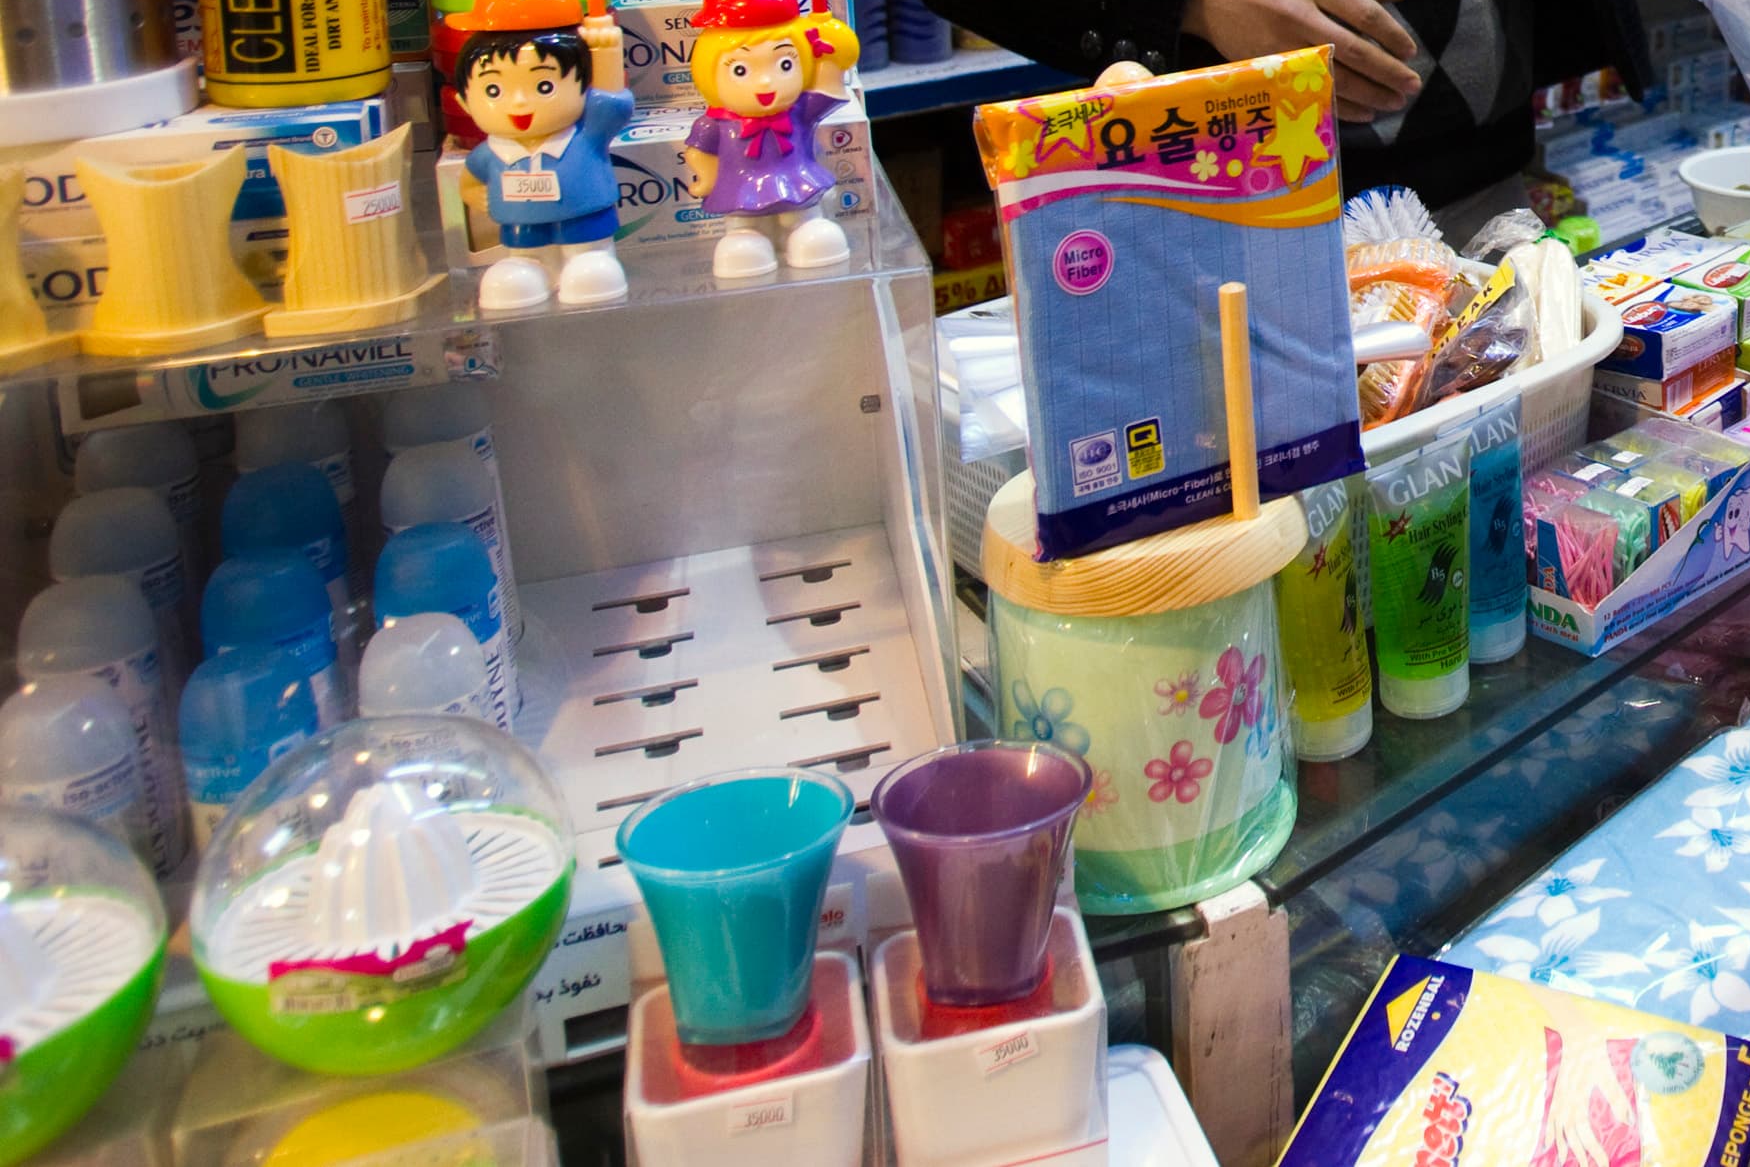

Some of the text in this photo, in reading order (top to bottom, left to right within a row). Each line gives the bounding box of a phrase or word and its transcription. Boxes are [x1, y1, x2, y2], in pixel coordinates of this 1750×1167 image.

[325, 16, 342, 50] DIRT
[303, 31, 321, 73] IDEAL
[1204, 90, 1271, 116] Dishcloth
[1043, 98, 1106, 138] 초극세사
[514, 177, 552, 194] 35000
[1063, 244, 1104, 266] Micro
[1066, 263, 1103, 281] Fiber
[1302, 439, 1321, 456] 행주
[1388, 455, 1464, 507] GLAN
[1185, 488, 1214, 505] CLEAN
[1408, 526, 1431, 545] Hair
[1431, 567, 1447, 582] B5
[1409, 650, 1431, 663] With
[1440, 654, 1463, 671] Hard
[1395, 973, 1447, 1054] ROZENBAL
